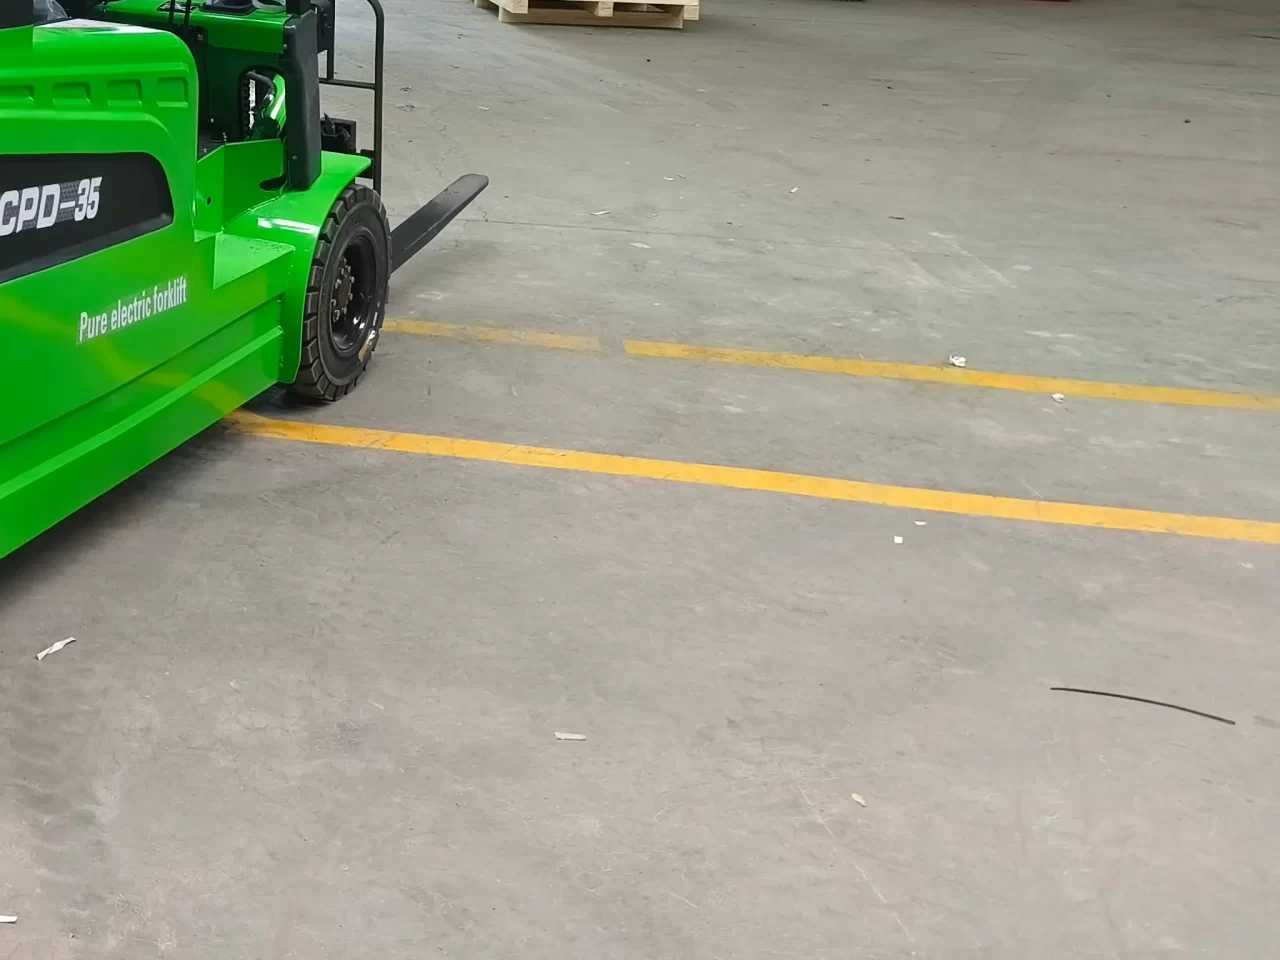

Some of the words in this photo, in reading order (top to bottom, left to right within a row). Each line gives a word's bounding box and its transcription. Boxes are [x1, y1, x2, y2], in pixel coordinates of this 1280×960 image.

[79, 311, 107, 343] Pure
[111, 290, 152, 331] electric
[152, 275, 187, 314] forklift
